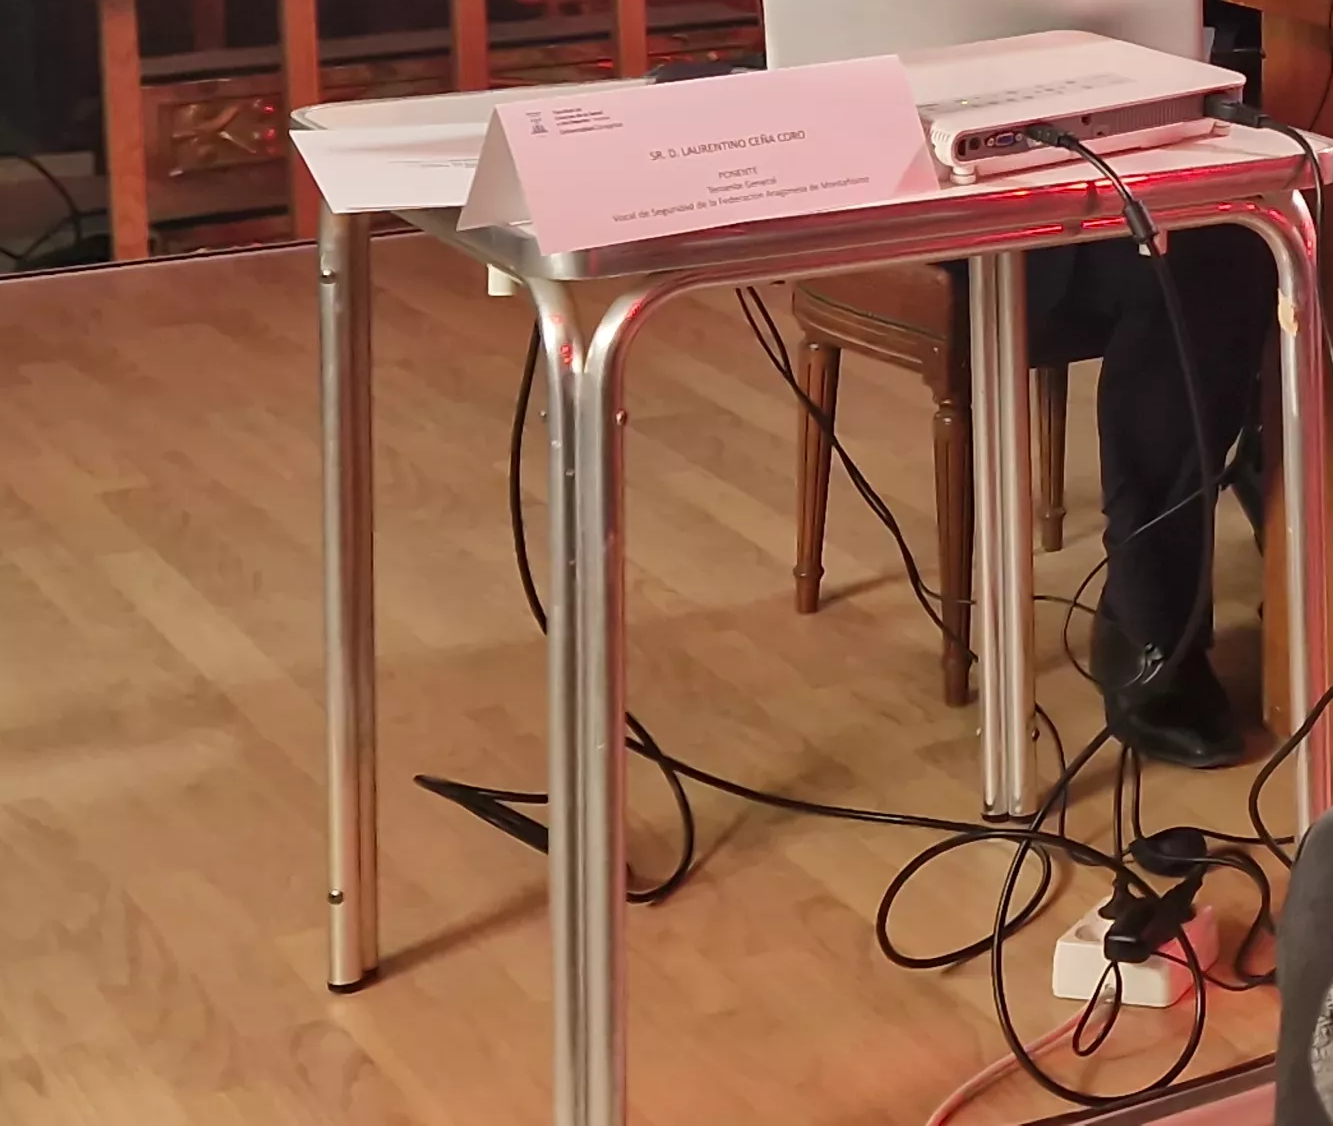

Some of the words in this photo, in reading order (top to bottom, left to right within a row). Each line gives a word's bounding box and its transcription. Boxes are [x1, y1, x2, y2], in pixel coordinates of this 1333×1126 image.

[649, 150, 666, 161] SR.
[668, 148, 679, 158] D.
[681, 139, 746, 157] LAURENTINO
